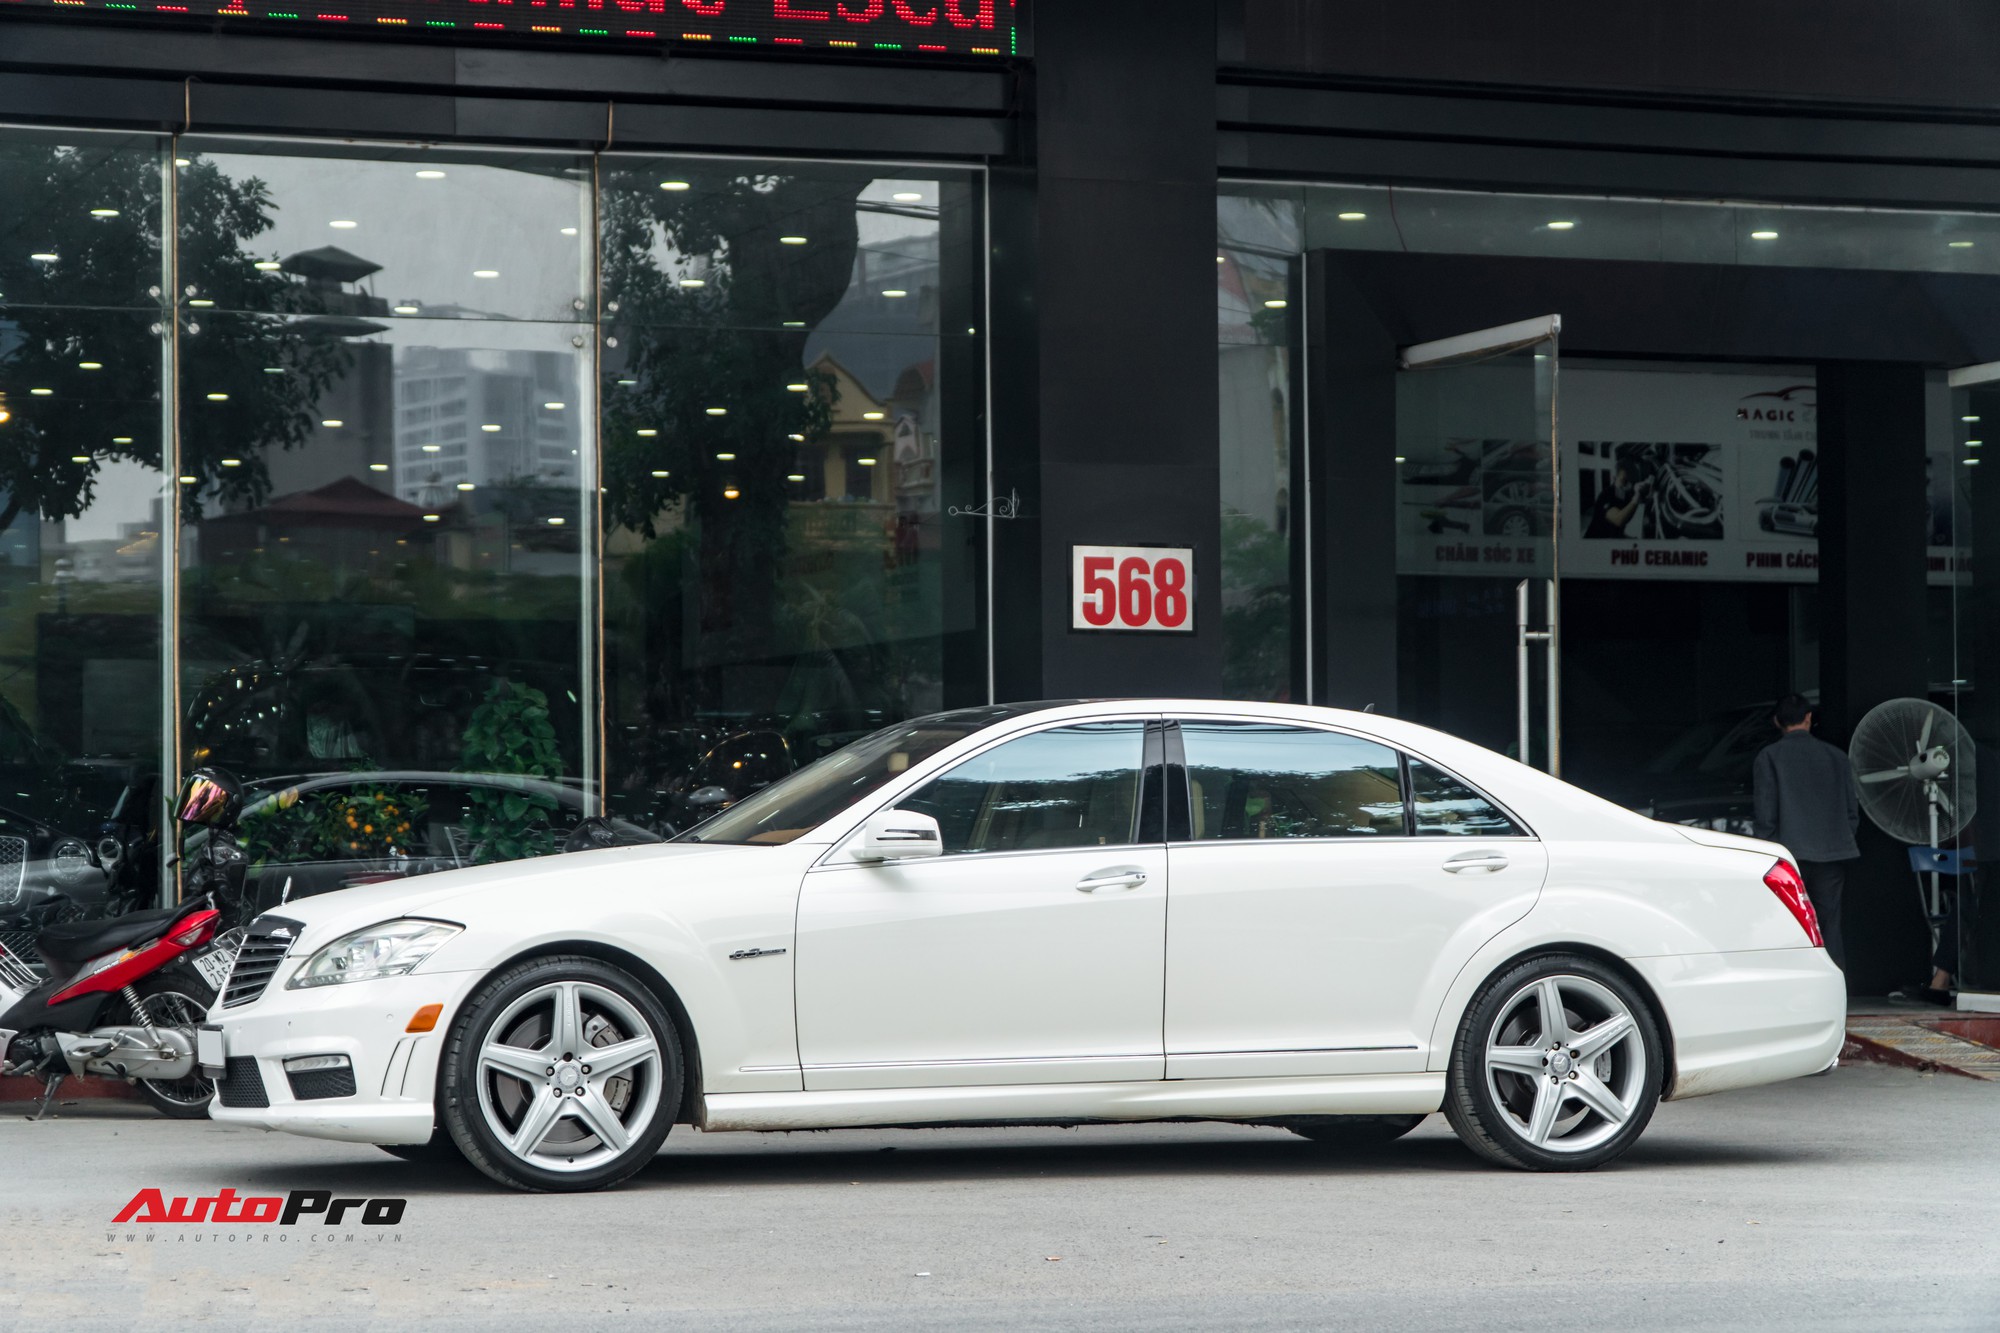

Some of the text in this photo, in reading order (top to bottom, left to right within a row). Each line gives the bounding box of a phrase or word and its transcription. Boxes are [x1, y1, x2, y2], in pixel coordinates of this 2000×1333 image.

[1517, 547, 1535, 563] XE
[1611, 543, 1708, 566] PHỦ CERAMIC
[1746, 552, 1782, 568] PHIM
[1082, 556, 1187, 628] 568
